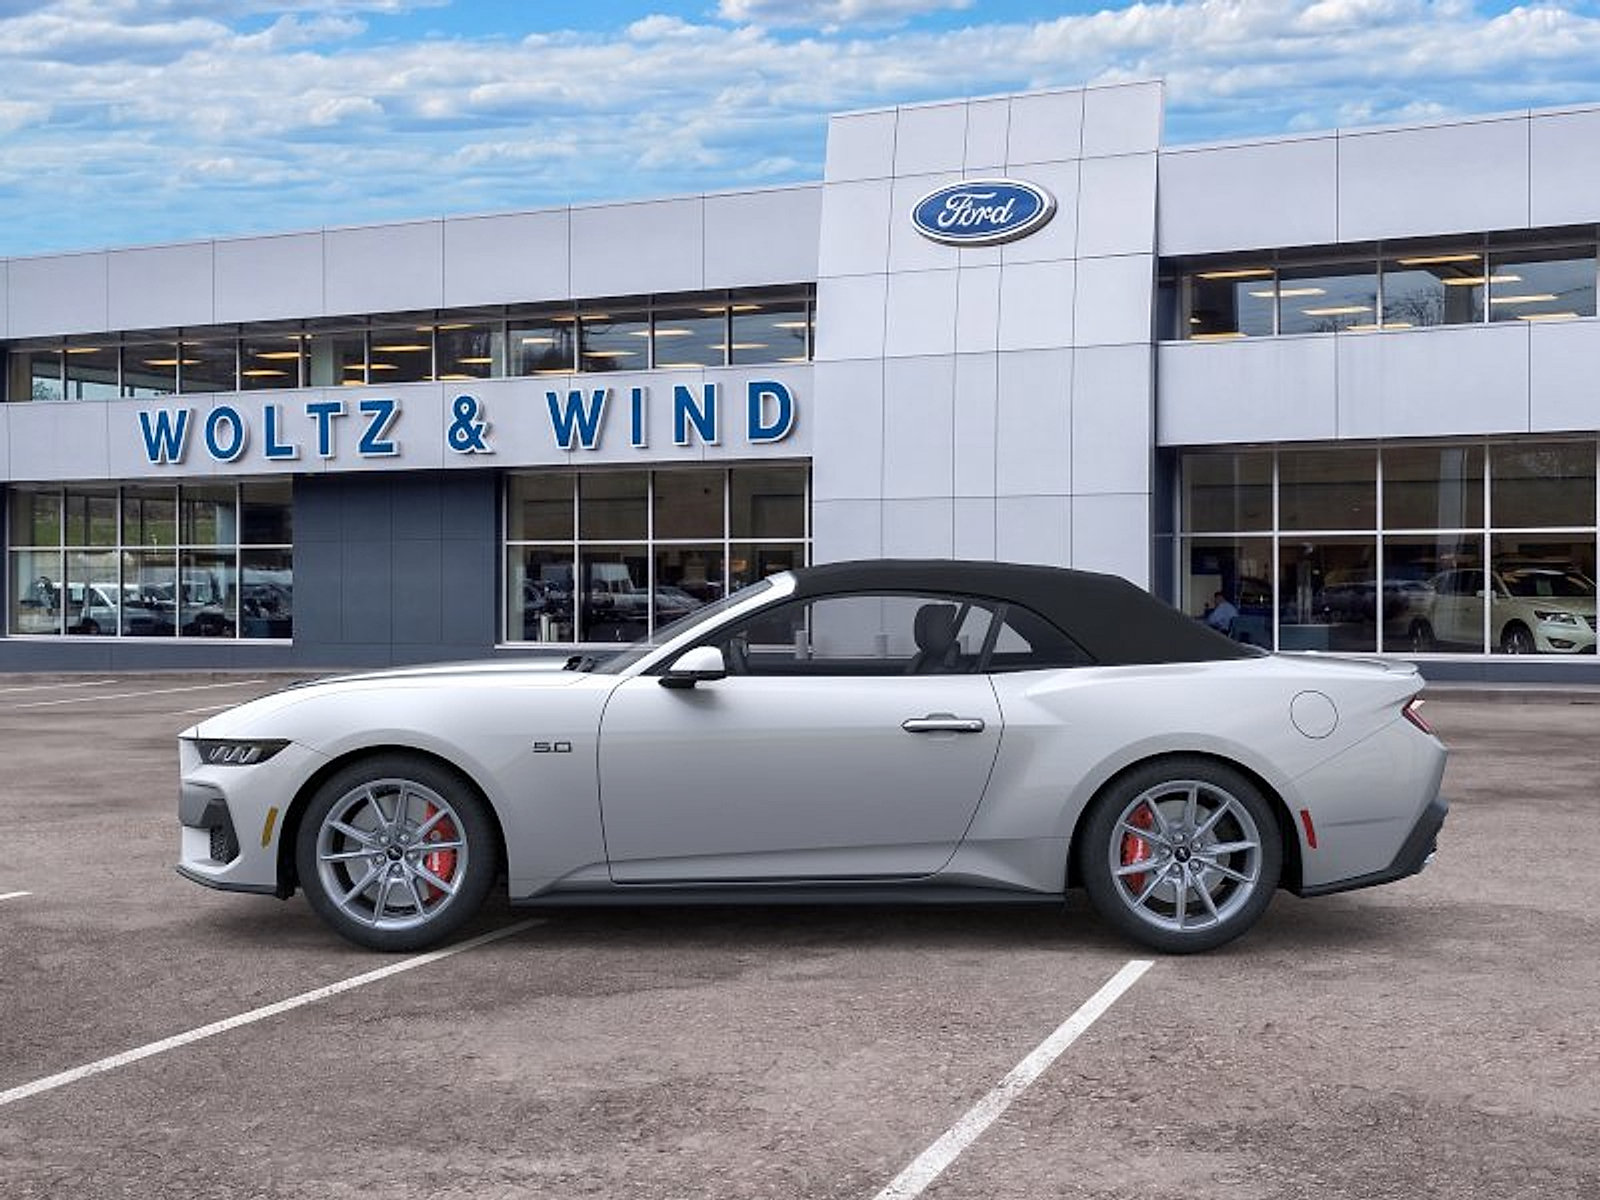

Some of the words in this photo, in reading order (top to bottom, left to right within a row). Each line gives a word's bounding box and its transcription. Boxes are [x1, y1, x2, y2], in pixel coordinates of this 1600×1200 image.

[938, 192, 1015, 227] Ford
[139, 399, 402, 463] WOLTZ
[448, 394, 493, 454] &
[545, 380, 796, 449] WIND
